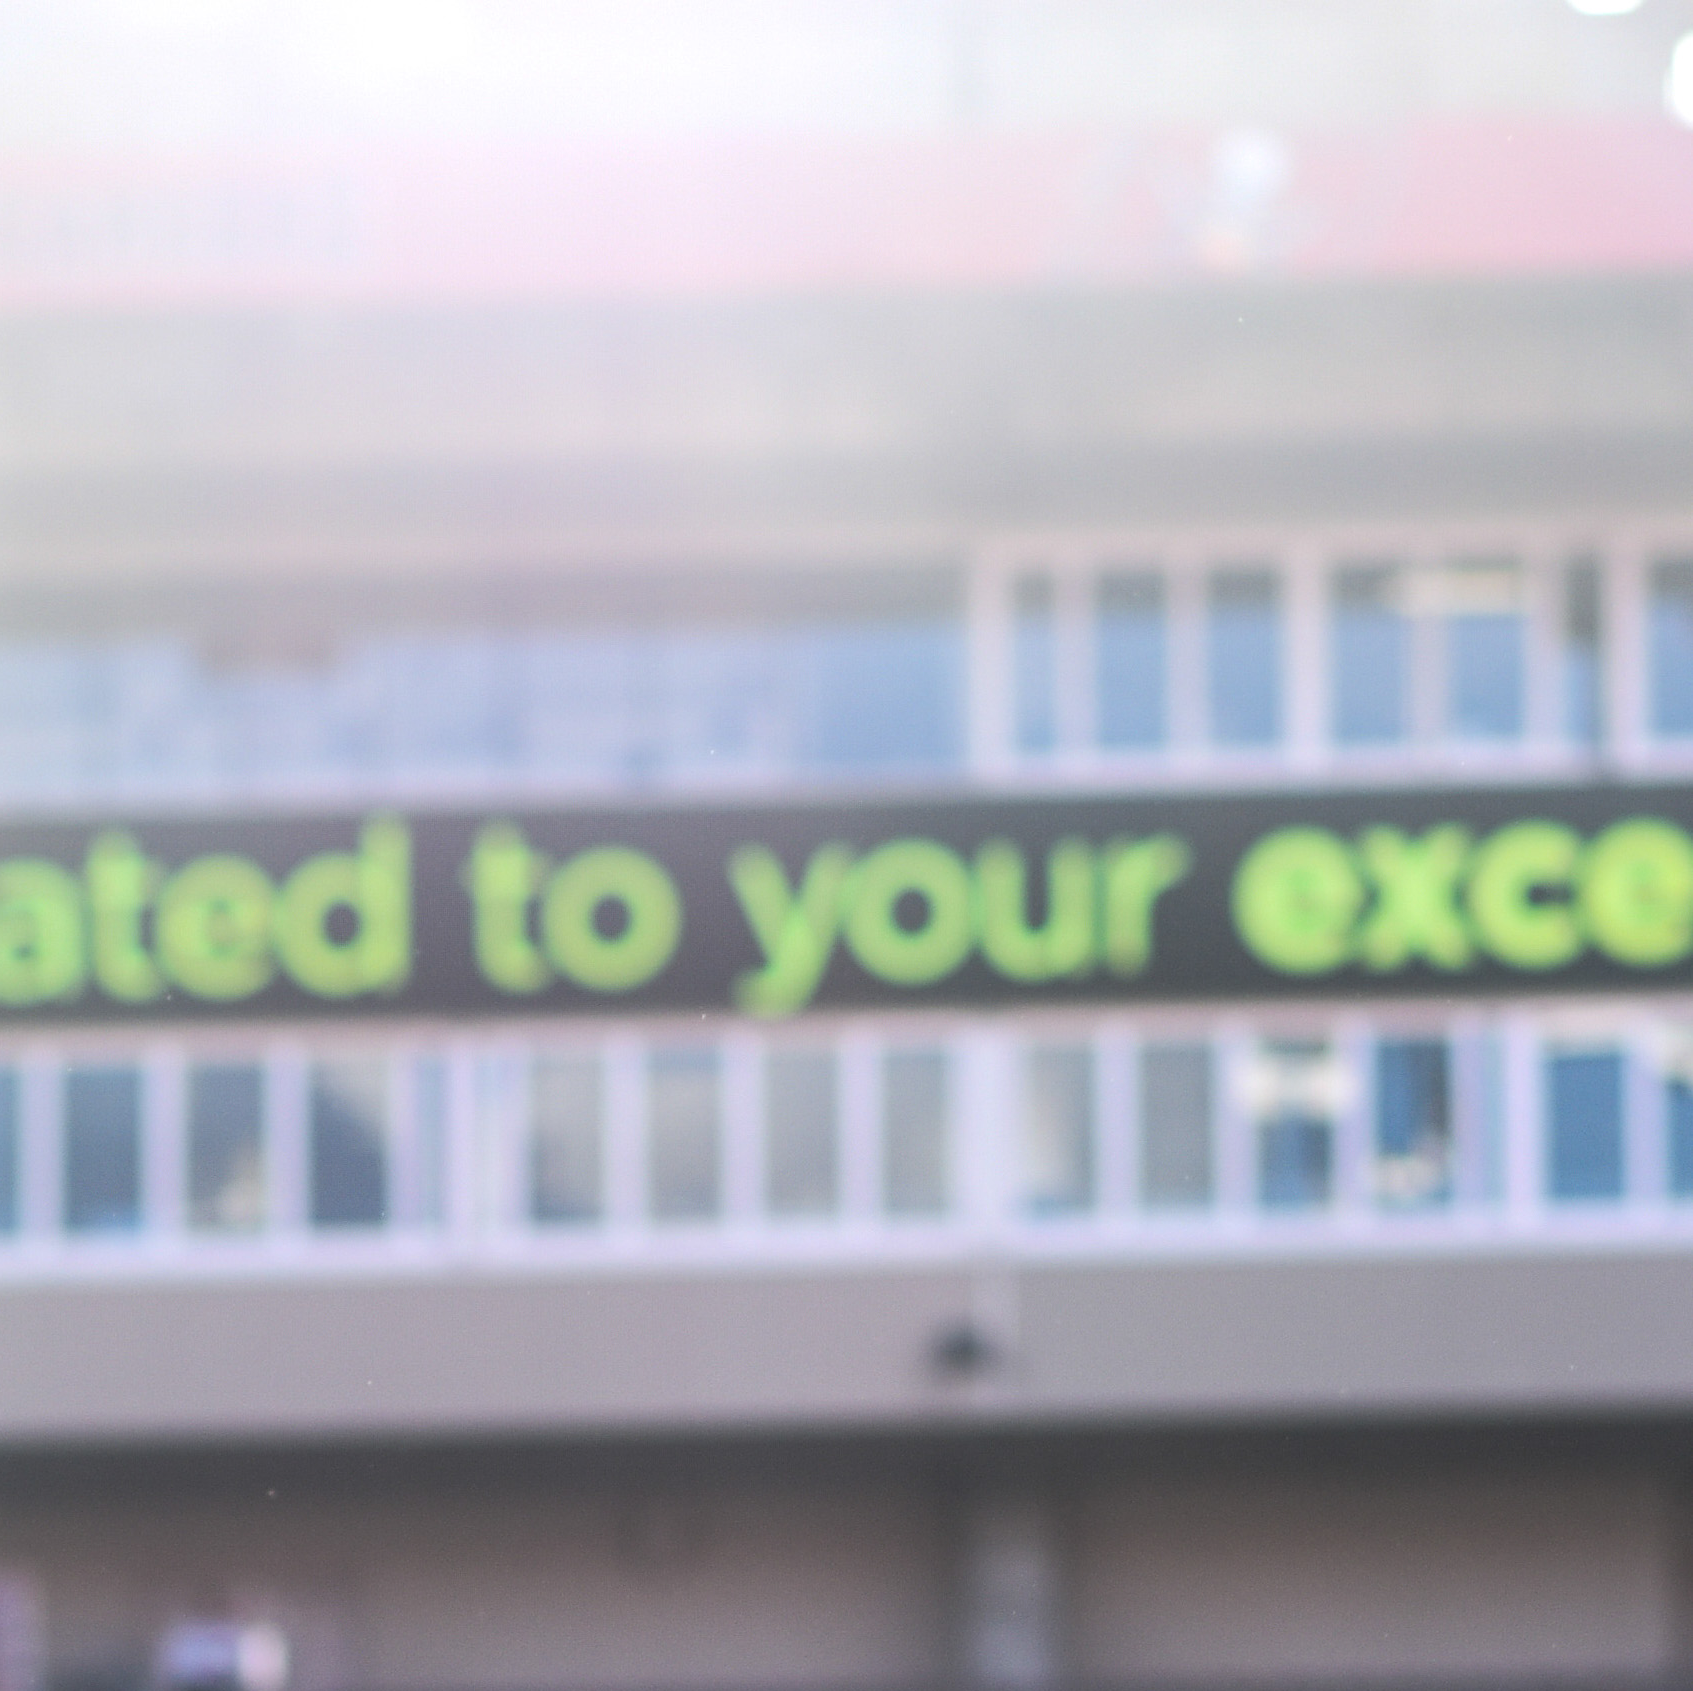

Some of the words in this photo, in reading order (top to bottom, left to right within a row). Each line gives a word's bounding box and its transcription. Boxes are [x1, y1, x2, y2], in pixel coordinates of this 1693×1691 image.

[464, 817, 685, 996] to
[725, 836, 1193, 1020] your
[1229, 817, 1693, 978] exce
